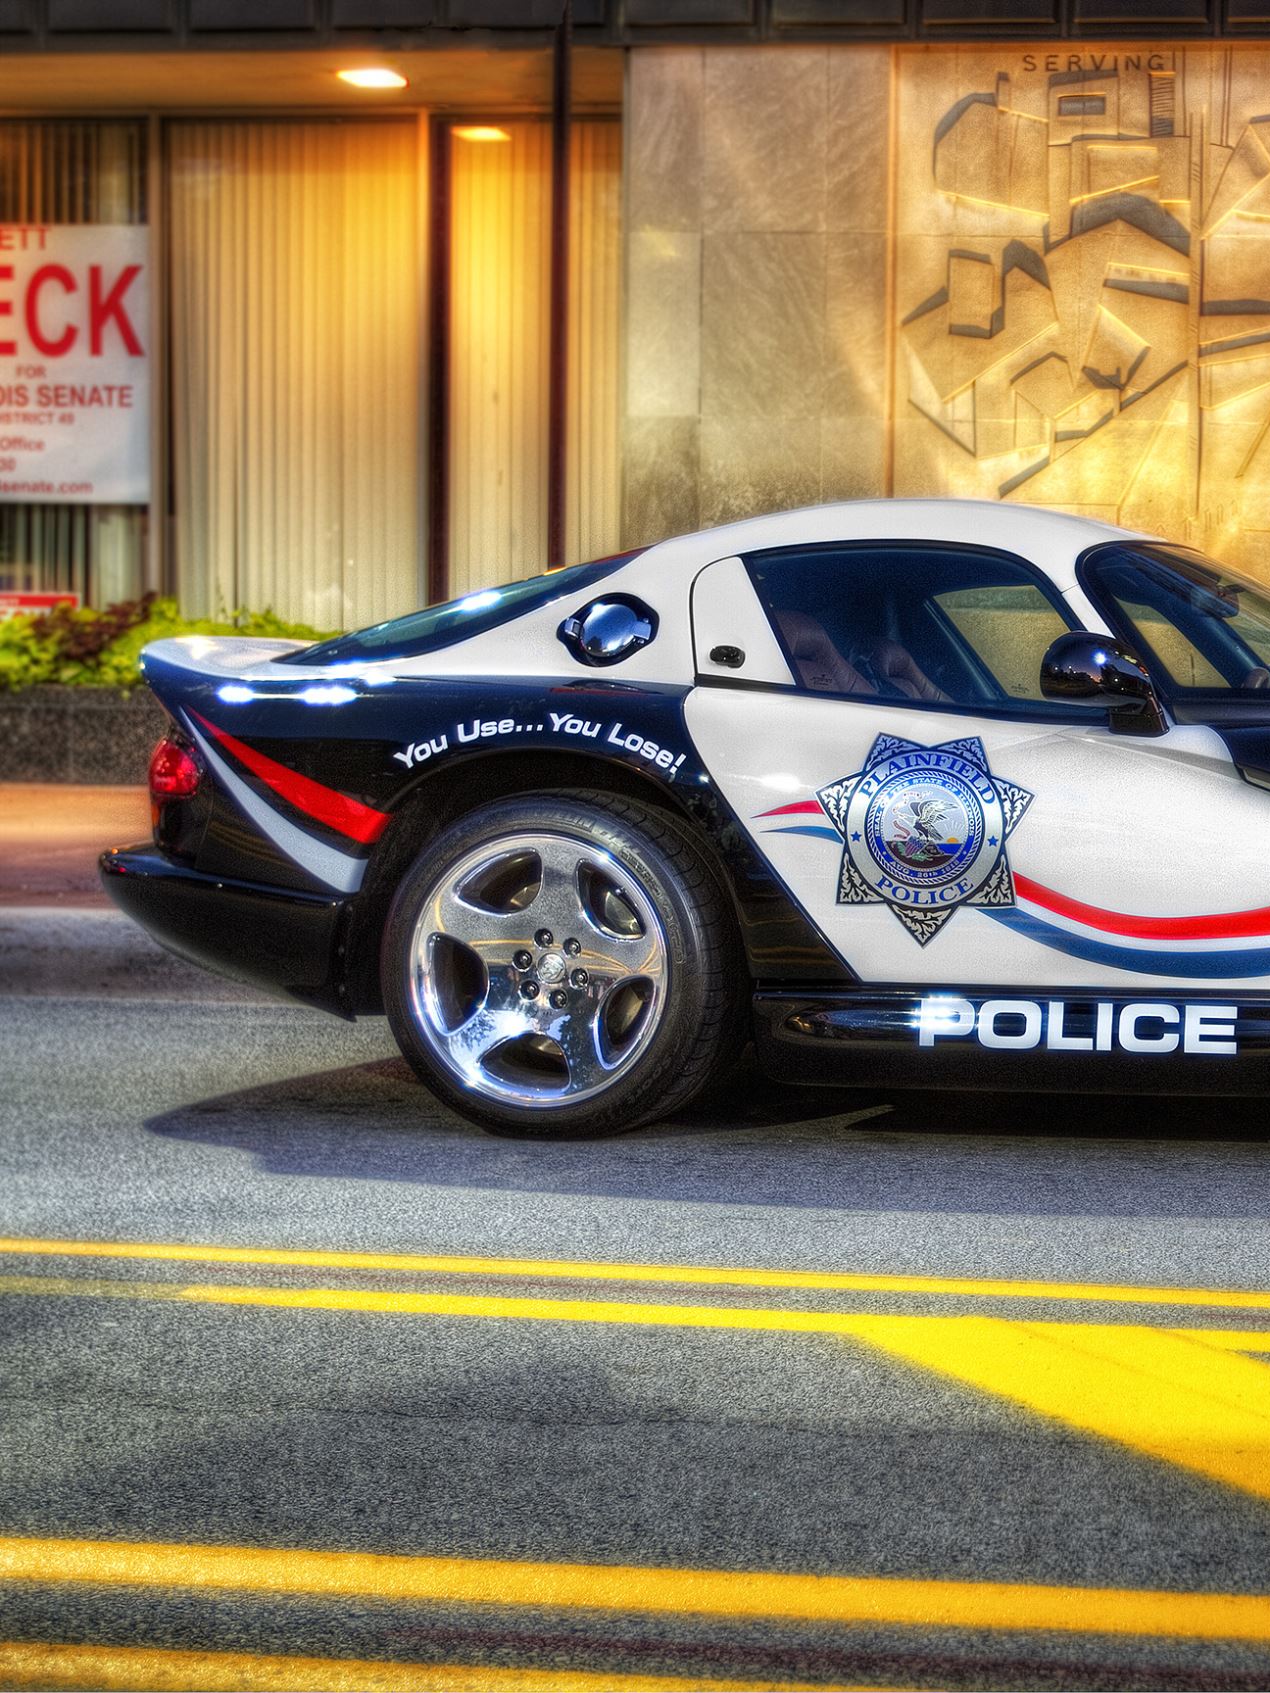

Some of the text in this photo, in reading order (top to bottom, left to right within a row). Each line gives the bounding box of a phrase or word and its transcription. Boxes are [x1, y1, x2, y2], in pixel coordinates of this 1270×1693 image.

[1022, 54, 1165, 72] SERVING
[15, 366, 47, 379] FOR
[36, 384, 133, 408] SENATE
[0, 412, 54, 425] ISTRICT
[393, 712, 687, 774] You Use... You Lose!
[858, 753, 996, 804] PLAINFIELD
[913, 777, 943, 785] STATE
[959, 793, 974, 837] ILLINOIS
[875, 874, 974, 905] POLICE
[918, 999, 1238, 1055] POLICE
